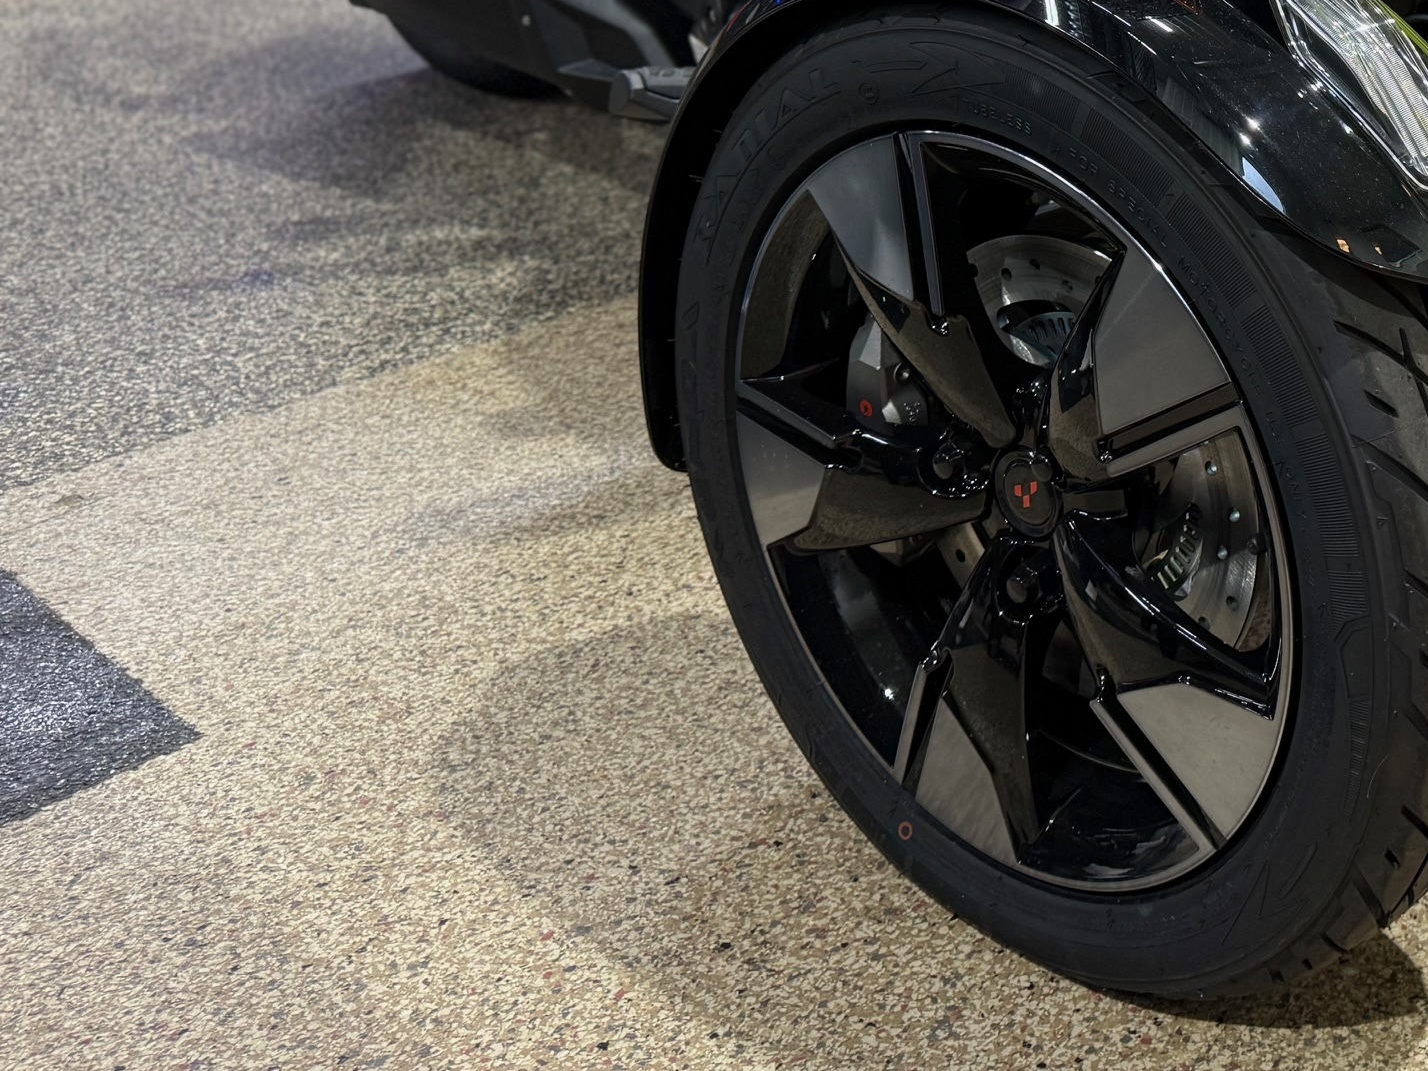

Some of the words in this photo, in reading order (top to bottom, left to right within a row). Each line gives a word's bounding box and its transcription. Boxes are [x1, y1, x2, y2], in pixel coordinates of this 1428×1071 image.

[963, 98, 1032, 135] TUBELESS
[1068, 146, 1100, 178] FOR
[1107, 178, 1170, 248] SPECIAL
